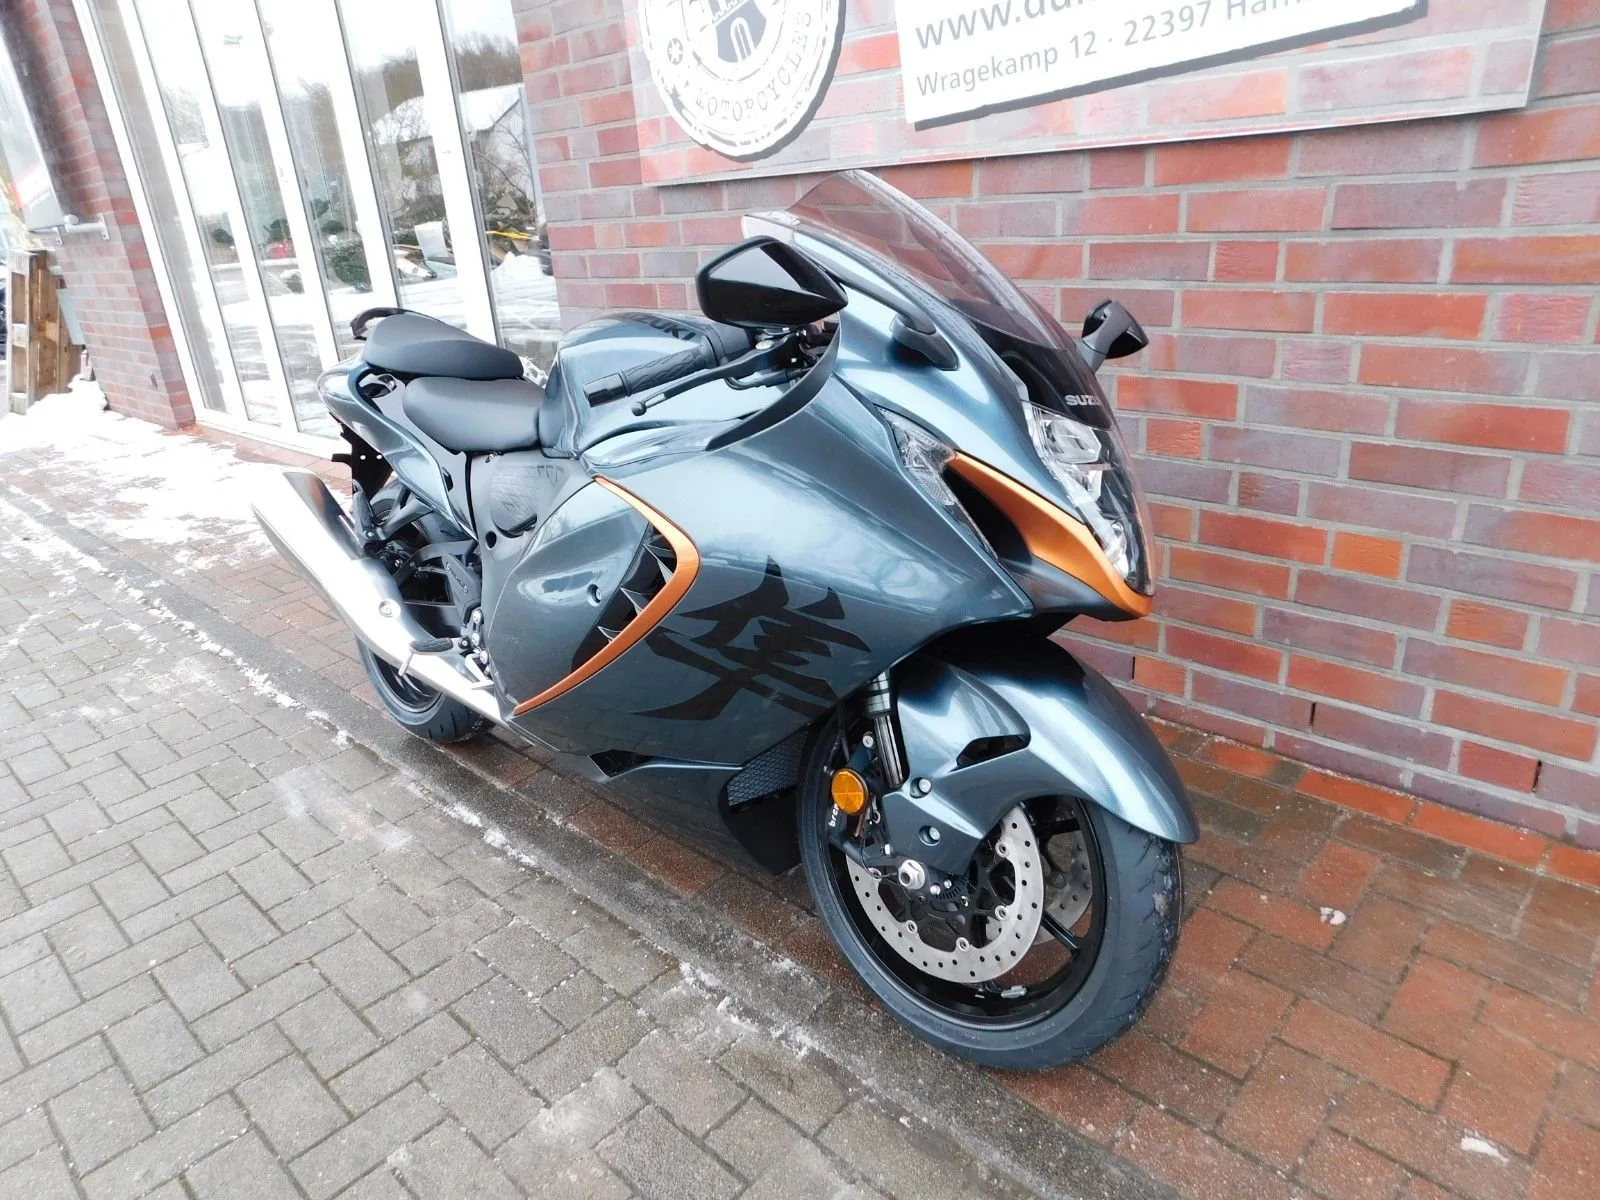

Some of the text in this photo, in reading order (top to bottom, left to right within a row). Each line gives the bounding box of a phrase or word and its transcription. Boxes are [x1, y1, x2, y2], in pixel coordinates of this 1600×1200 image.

[916, 46, 1059, 97] Wragekamp
[1069, 30, 1097, 59] 12
[1123, 2, 1212, 47] 22397
